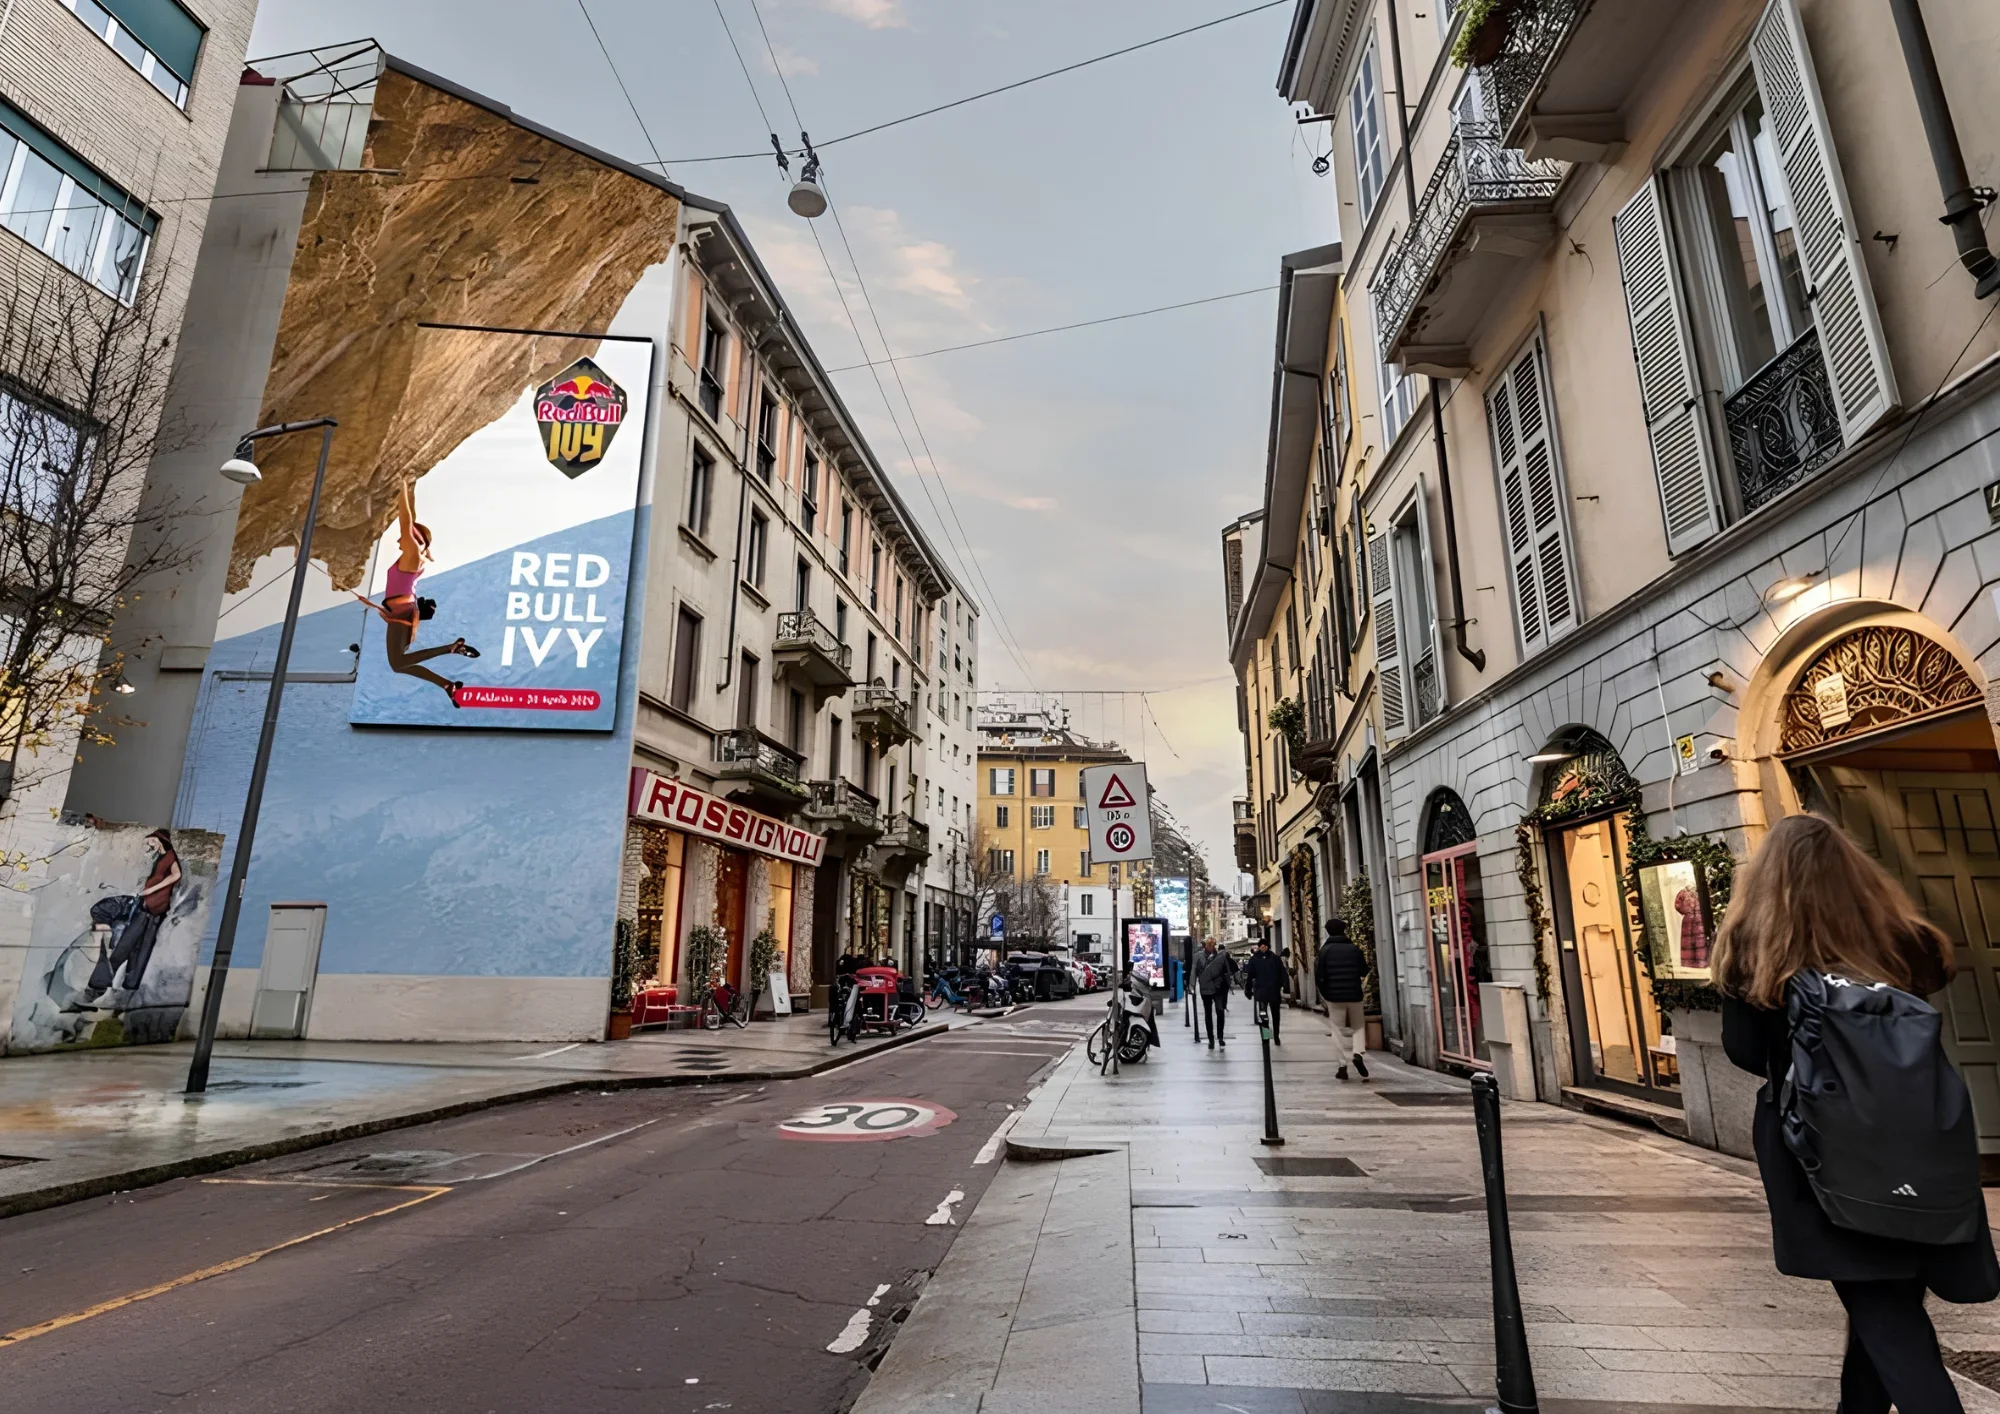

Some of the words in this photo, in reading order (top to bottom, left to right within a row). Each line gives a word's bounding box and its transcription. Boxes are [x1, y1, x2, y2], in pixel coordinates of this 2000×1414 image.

[510, 551, 610, 588] RED
[506, 591, 607, 623] BULL
[501, 626, 604, 668] IVY
[782, 1105, 920, 1130] 30
